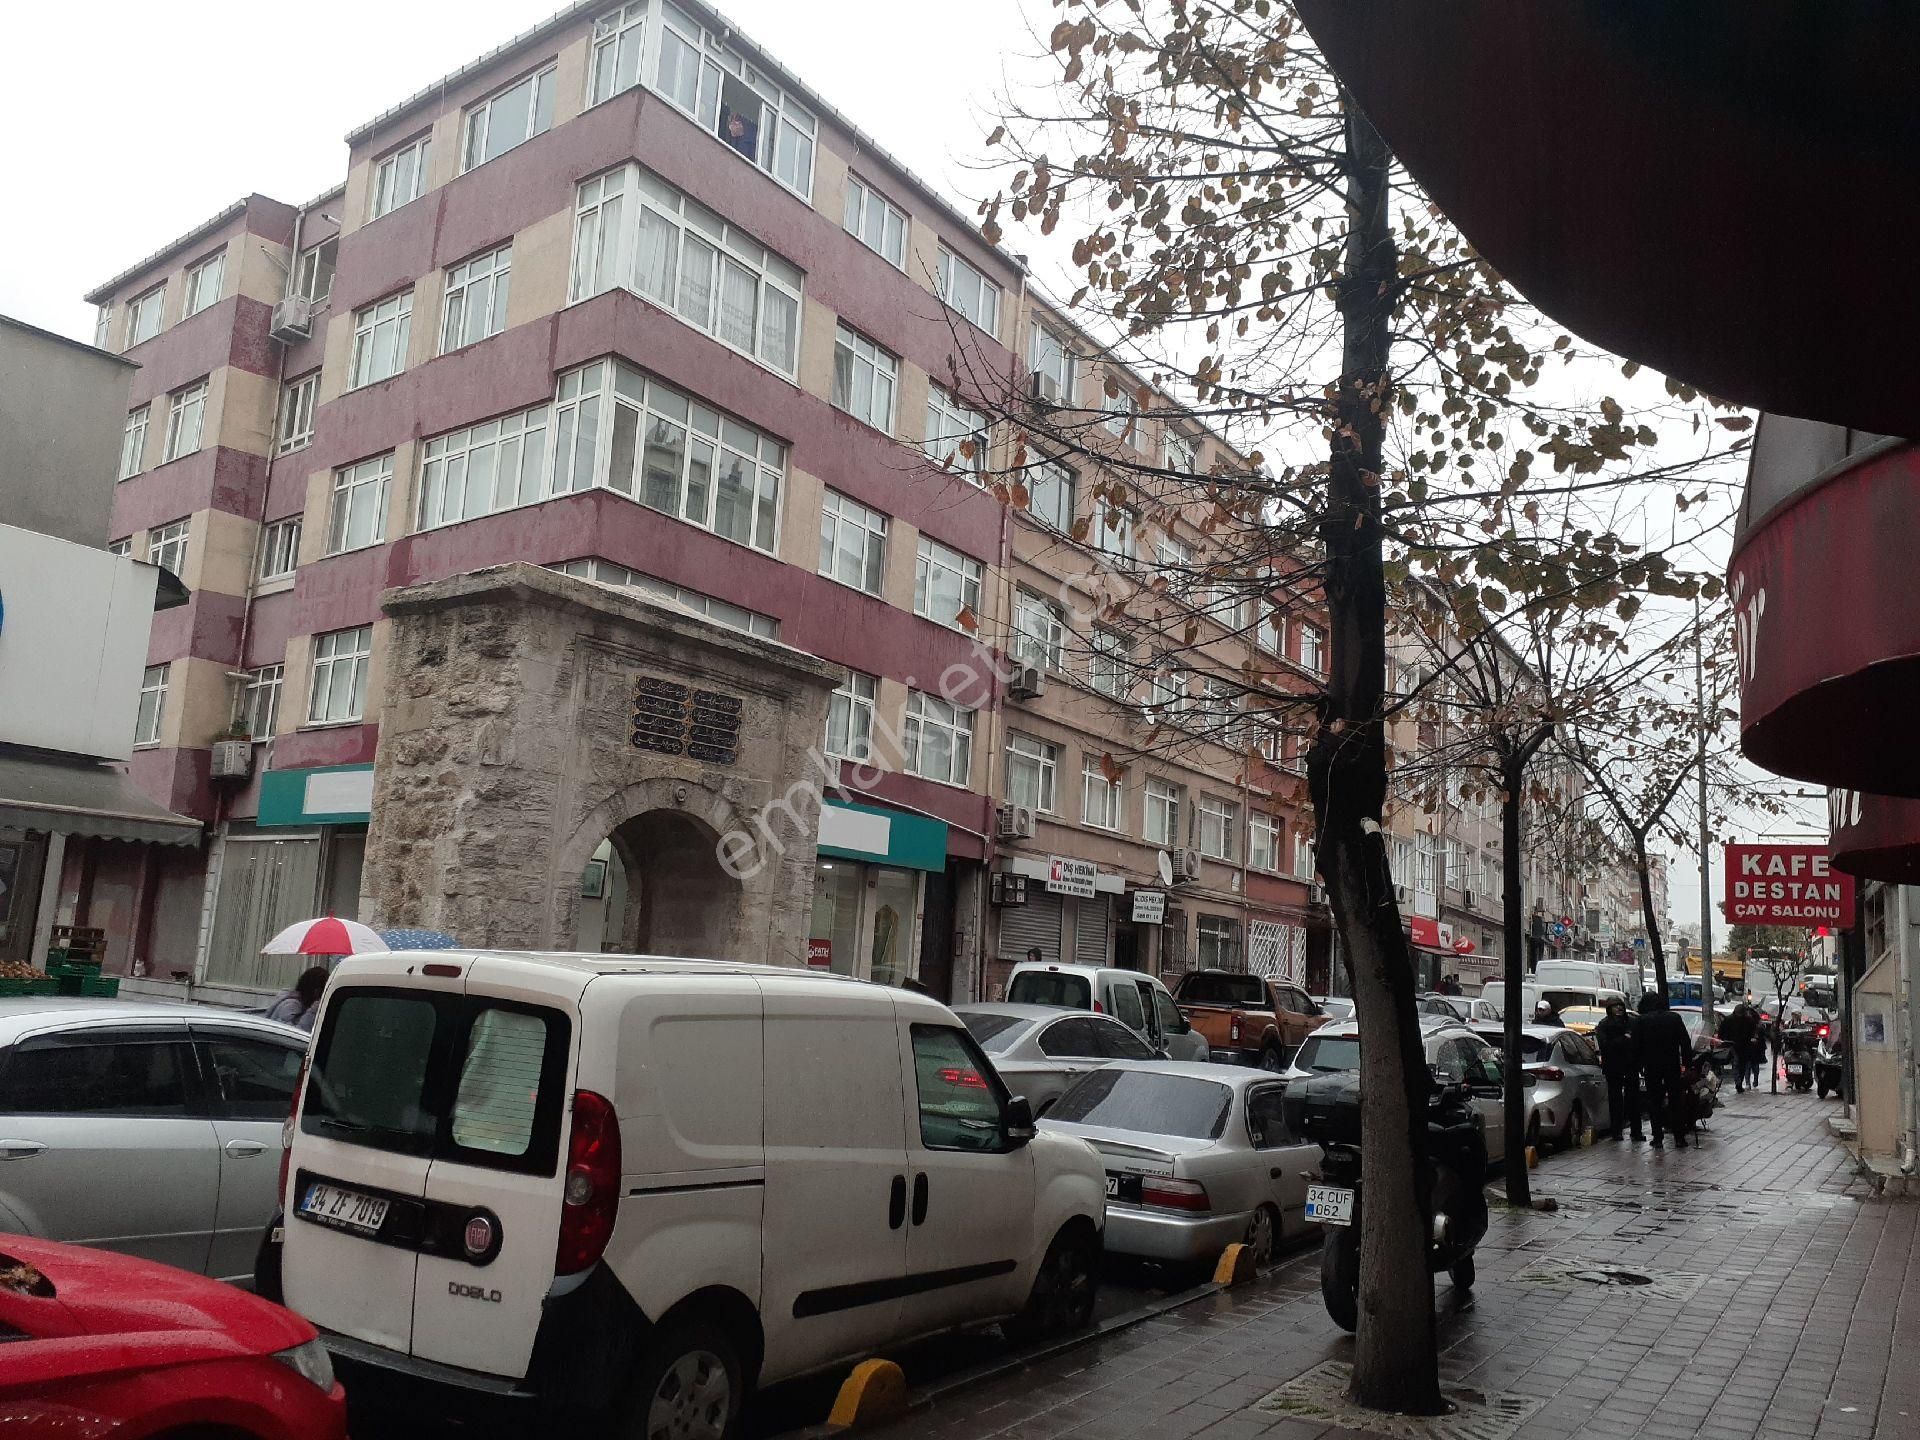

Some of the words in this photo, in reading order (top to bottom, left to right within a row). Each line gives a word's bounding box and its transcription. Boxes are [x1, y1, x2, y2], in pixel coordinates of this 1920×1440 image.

[1064, 861, 1073, 875] DİŞ
[1074, 864, 1095, 876] HEKİMİ
[1742, 854, 1830, 877] KAFE
[1735, 882, 1841, 901] DESTAN
[1735, 904, 1766, 918] ÇAY
[1772, 905, 1840, 919] SALONU
[311, 1186, 329, 1211] 34
[329, 1190, 352, 1216] ZF
[349, 1195, 386, 1225] 7019
[1310, 1190, 1324, 1201] 34
[1328, 1191, 1351, 1204] CUF
[1316, 1203, 1338, 1217] 062
[470, 1227, 487, 1246] FIAT
[448, 1281, 502, 1303] DOBLO
